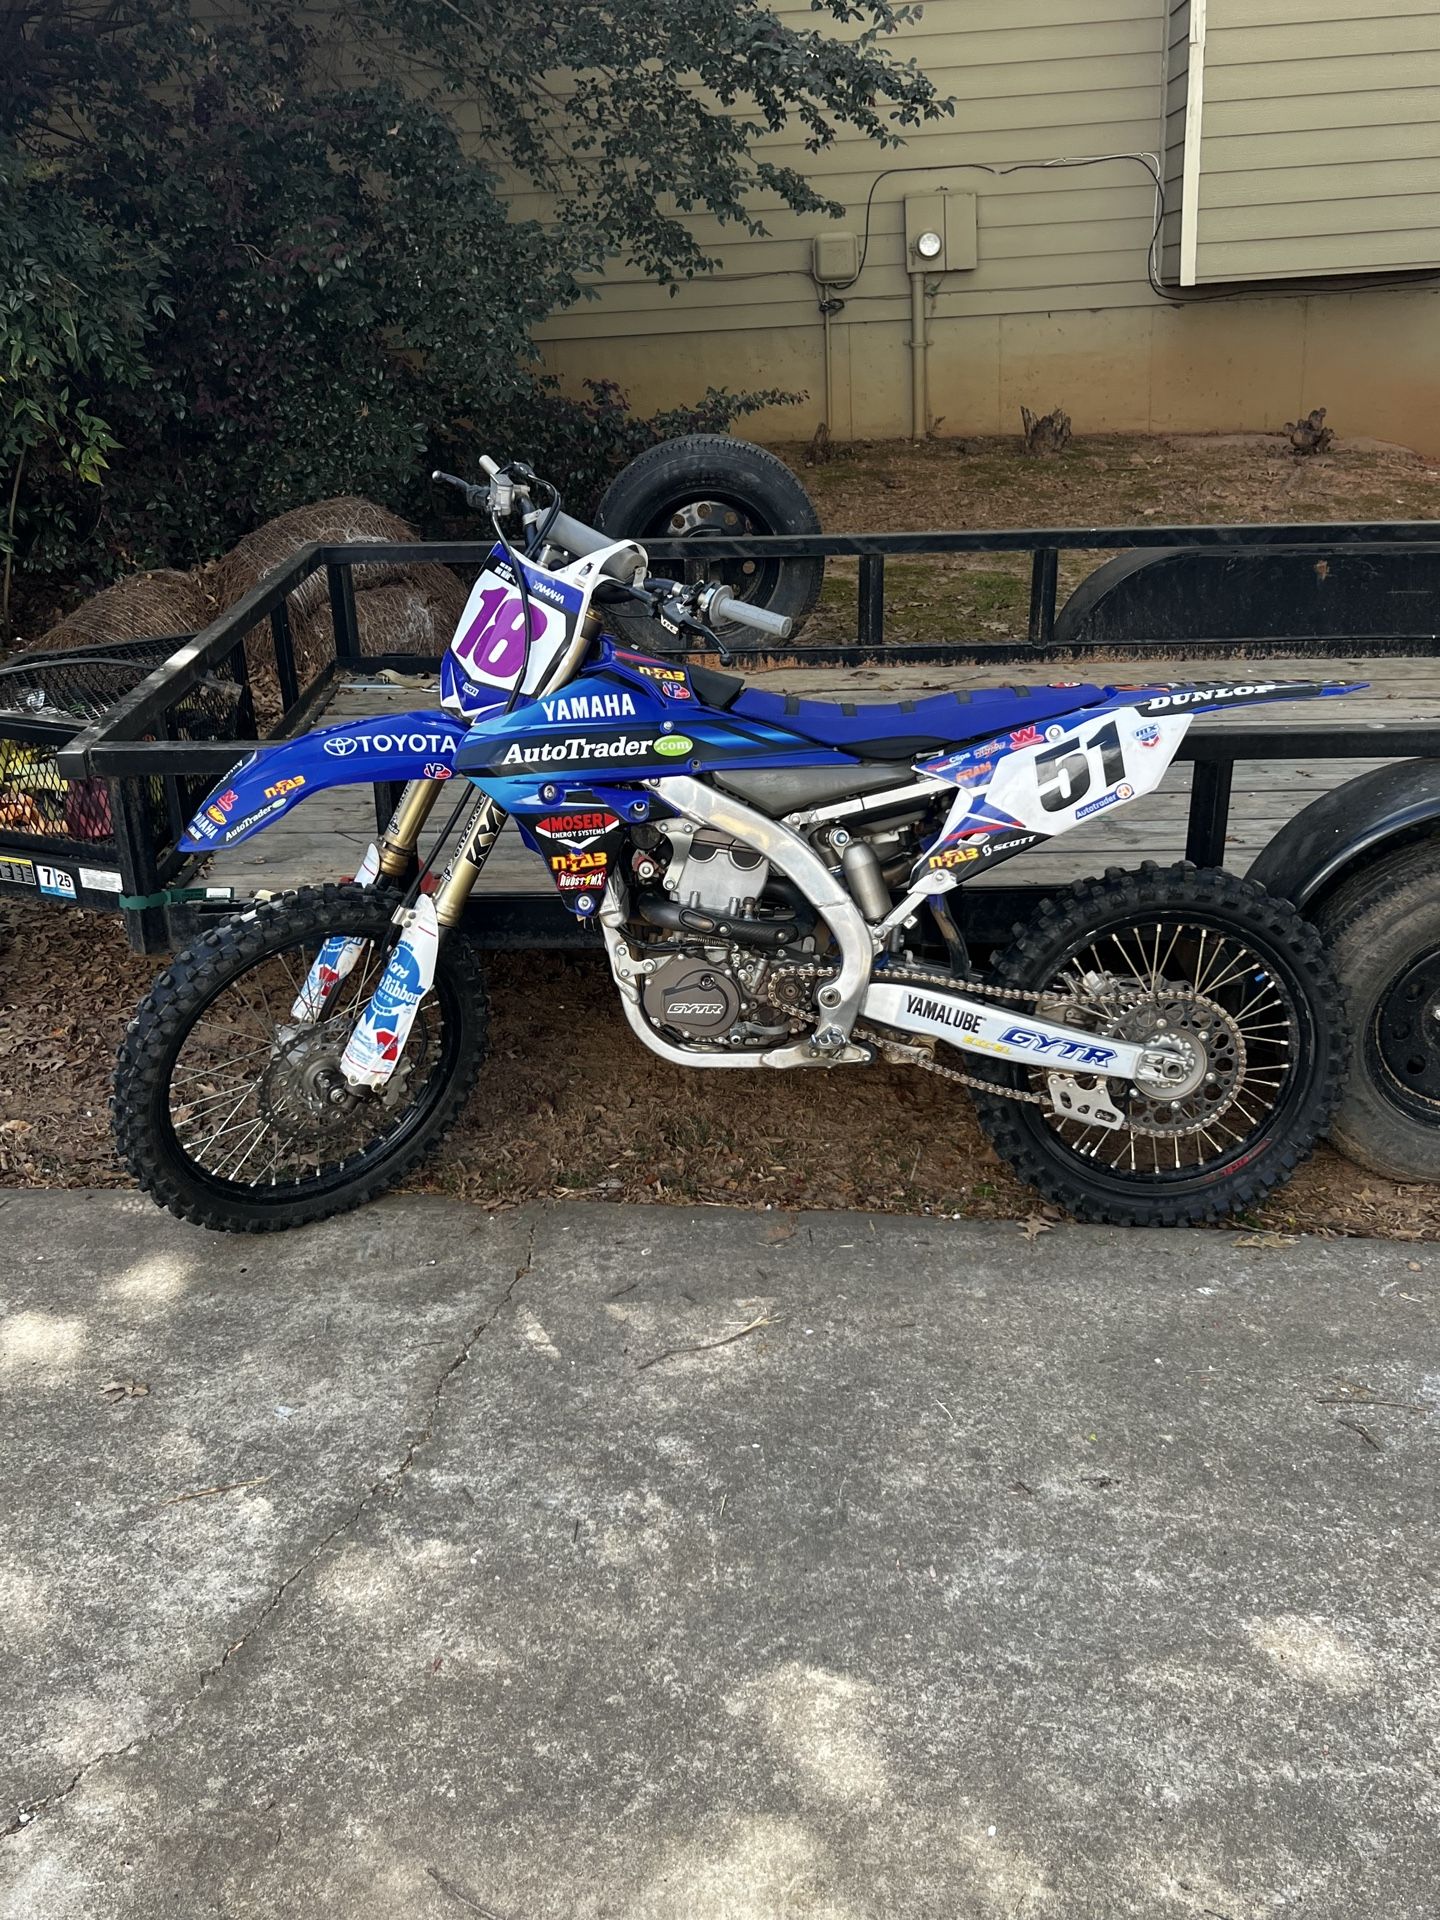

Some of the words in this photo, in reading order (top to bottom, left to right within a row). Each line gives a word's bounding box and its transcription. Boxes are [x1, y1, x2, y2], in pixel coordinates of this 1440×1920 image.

[533, 581, 565, 604] YAMAHA
[456, 587, 547, 678] 18
[541, 693, 636, 721] YAMAHA
[1148, 684, 1276, 711] DUNLOP
[356, 733, 457, 753] TOYOTA
[501, 736, 653, 765] AutoTrader
[1035, 720, 1126, 812] 51
[1076, 794, 1117, 819] Autotrader
[226, 805, 272, 841] AutoTrader
[551, 813, 603, 831] MOSER
[552, 831, 577, 839] ENERGY
[578, 828, 605, 837] SYSTEMS
[993, 835, 1036, 852] SCOTT
[43, 868, 51, 885] 7
[57, 873, 71, 888] 25
[383, 974, 420, 1006] Ribbon
[667, 1003, 724, 1014] GYTR
[906, 994, 982, 1034] YAMALUBE
[998, 1026, 1118, 1068] GYTR
